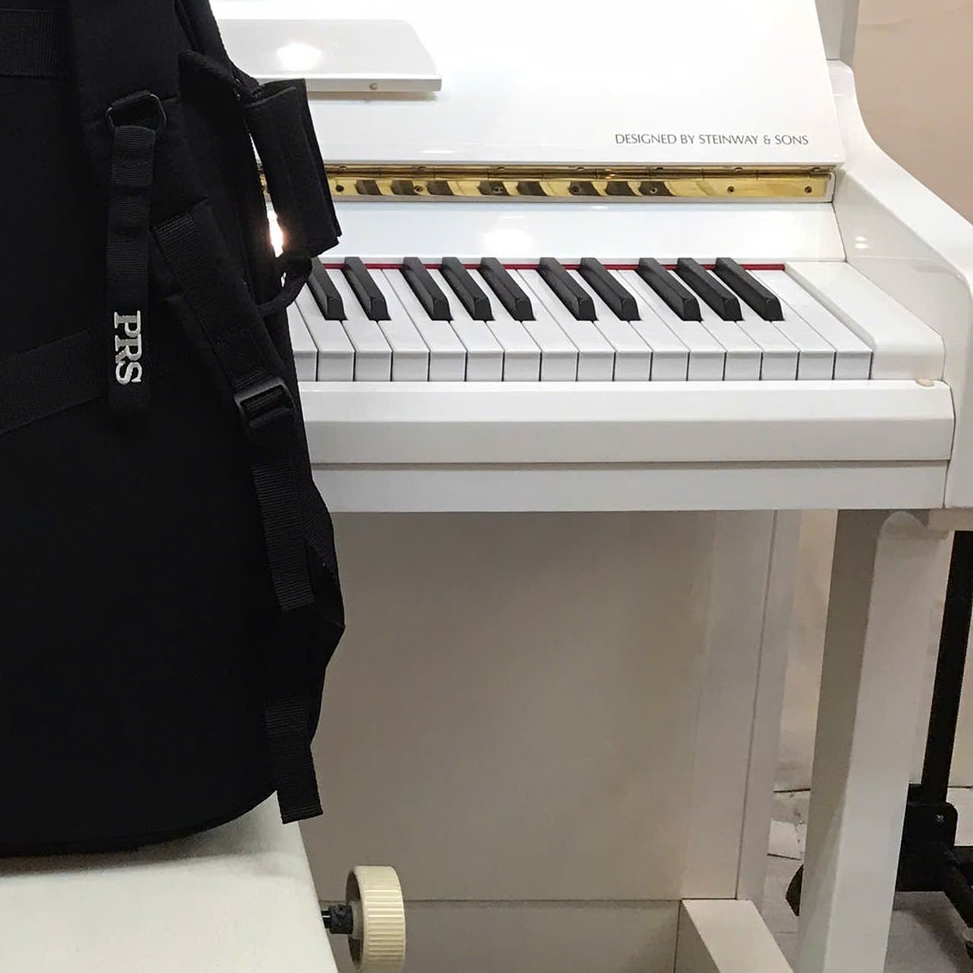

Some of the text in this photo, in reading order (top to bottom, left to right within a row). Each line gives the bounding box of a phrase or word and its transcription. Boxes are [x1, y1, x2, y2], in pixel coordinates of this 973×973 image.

[614, 133, 809, 146] DESIGNED BY STEINWAY & SONS
[113, 310, 143, 385] PRS
